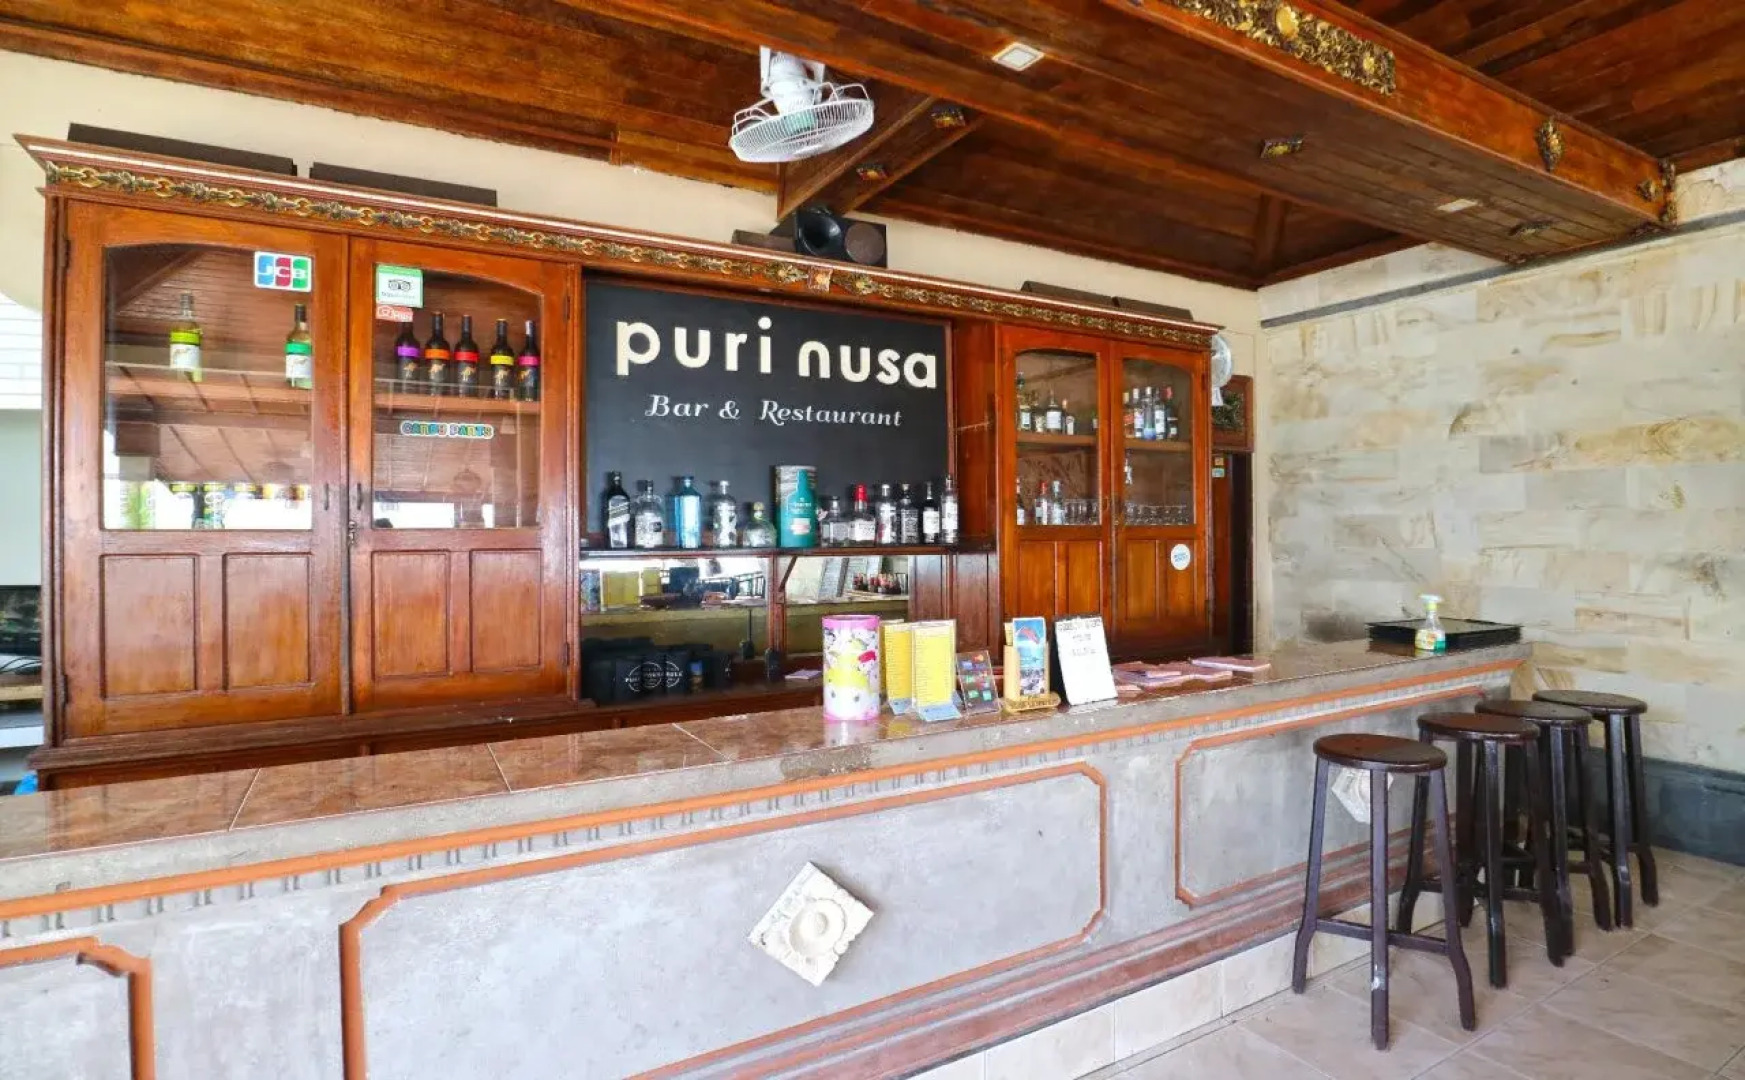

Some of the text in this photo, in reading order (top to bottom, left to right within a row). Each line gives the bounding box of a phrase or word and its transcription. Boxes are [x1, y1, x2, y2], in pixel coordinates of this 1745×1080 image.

[616, 316, 937, 389] puri nusa
[645, 394, 903, 427] Bar & Restaurant
